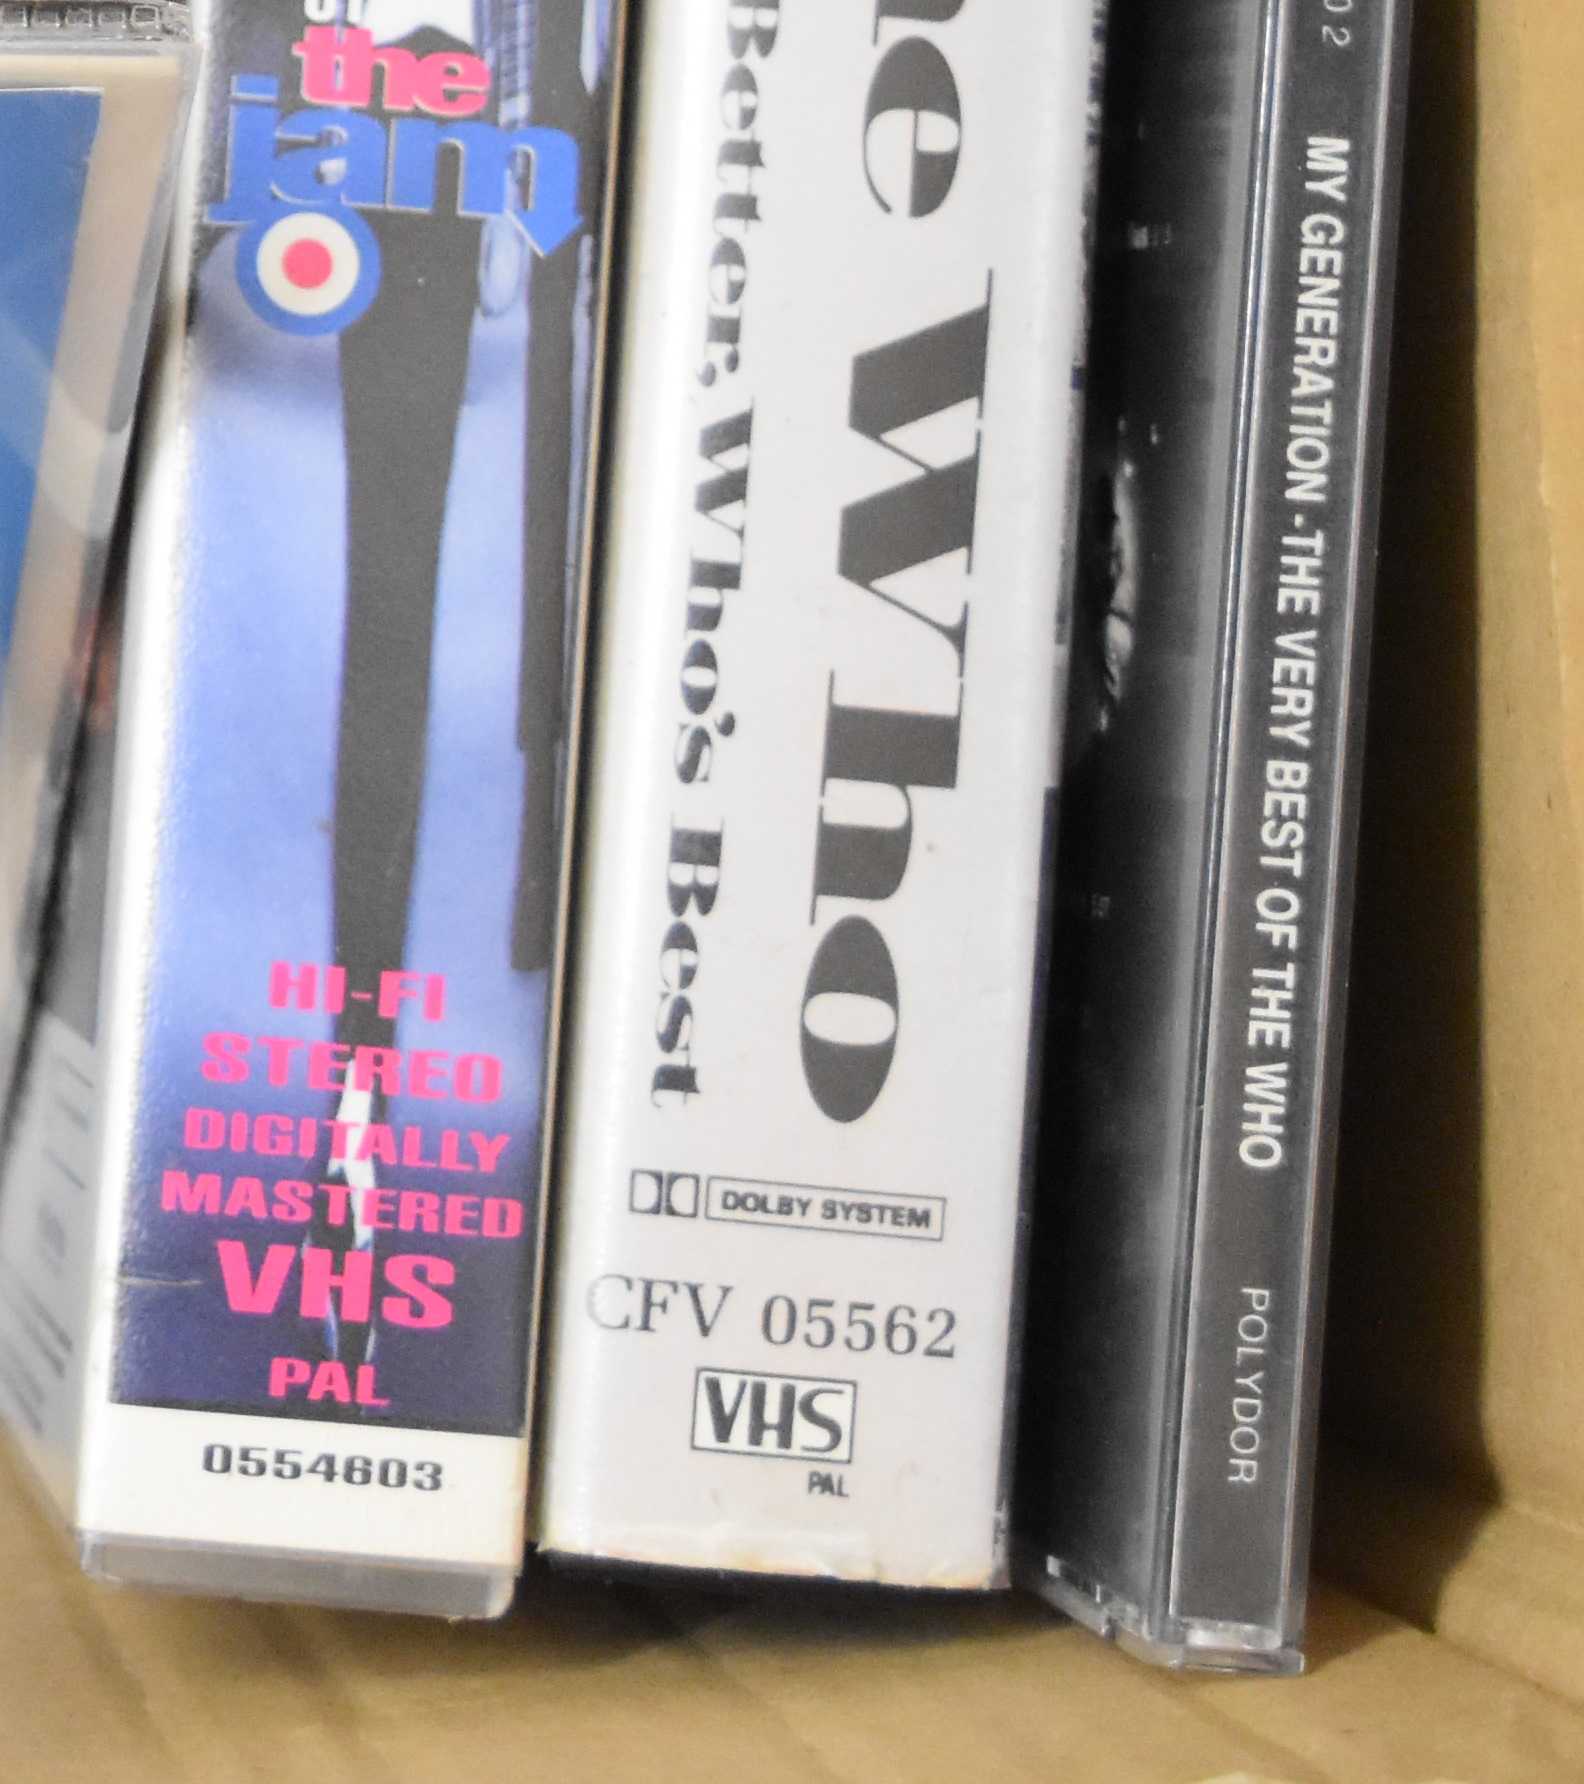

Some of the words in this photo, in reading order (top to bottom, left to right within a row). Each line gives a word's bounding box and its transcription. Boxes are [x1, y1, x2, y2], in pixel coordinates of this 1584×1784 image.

[292, 26, 492, 115] the
[1321, 23, 1352, 47] 2
[204, 74, 582, 256] jam
[1303, 135, 1351, 205] MY
[1284, 213, 1346, 504] GENERATION
[672, 395, 756, 786] Who's
[1275, 528, 1325, 617] THE
[799, 266, 994, 1125] Who
[1268, 629, 1320, 749] VERY
[1259, 759, 1310, 878] BEST
[649, 811, 725, 1111] Best
[1255, 888, 1302, 953] OF
[267, 960, 446, 1022] HI-FI
[1247, 963, 1295, 1050] THE
[200, 1031, 504, 1106] STEREO
[183, 1105, 511, 1174] DIGITALLY
[1238, 1061, 1288, 1169] WHO
[159, 1168, 524, 1240] MASTERED
[721, 1189, 813, 1217] DOLBY
[820, 1200, 932, 1230] SYSTEM
[215, 1238, 458, 1331] VHS
[586, 1272, 735, 1339] CFV
[760, 1294, 957, 1360] 05562
[267, 1354, 391, 1408] PAL
[704, 1375, 846, 1454] VHS
[1227, 1286, 1271, 1485] POLYDOR
[807, 1469, 851, 1499] PAL
